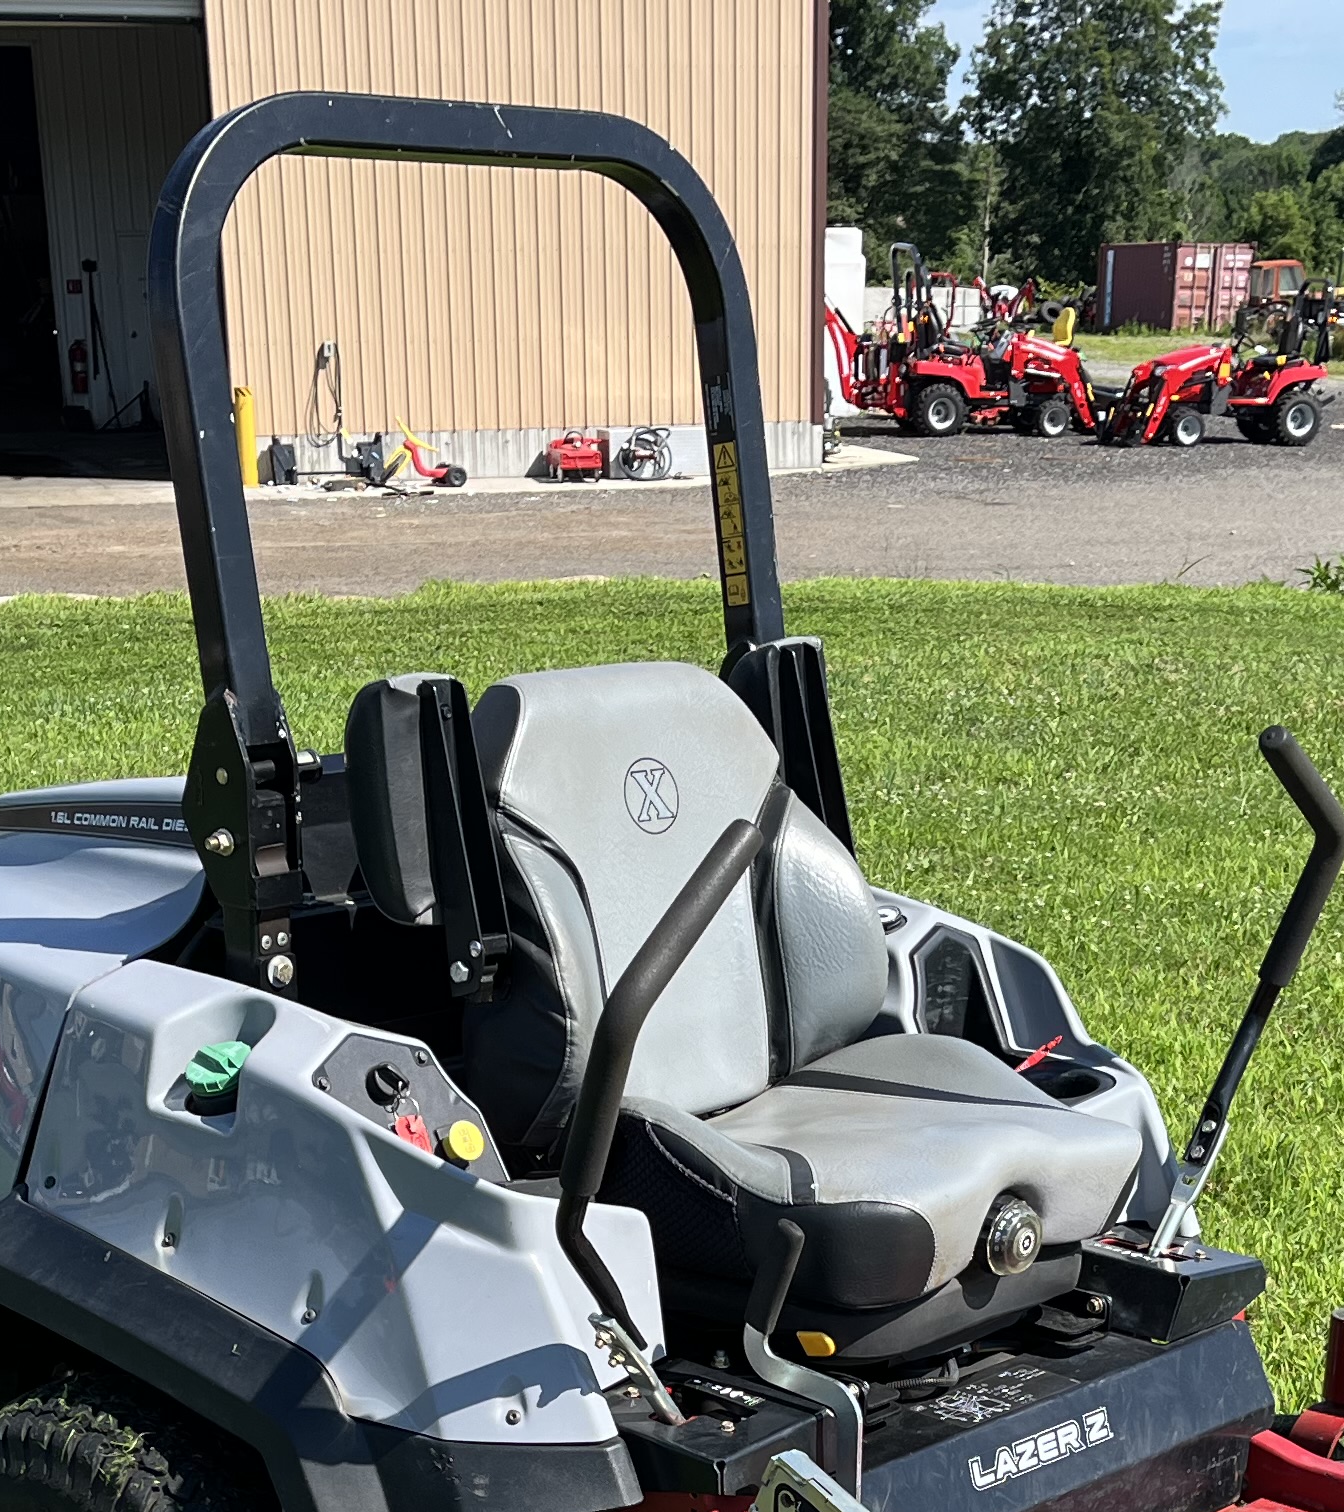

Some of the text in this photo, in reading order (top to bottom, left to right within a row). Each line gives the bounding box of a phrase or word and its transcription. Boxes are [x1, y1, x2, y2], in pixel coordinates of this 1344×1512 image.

[50, 811, 72, 824] 1.6L
[73, 813, 128, 828] COMMON
[129, 816, 159, 830] RAIL
[968, 1407, 1111, 1492] LAZER Z
